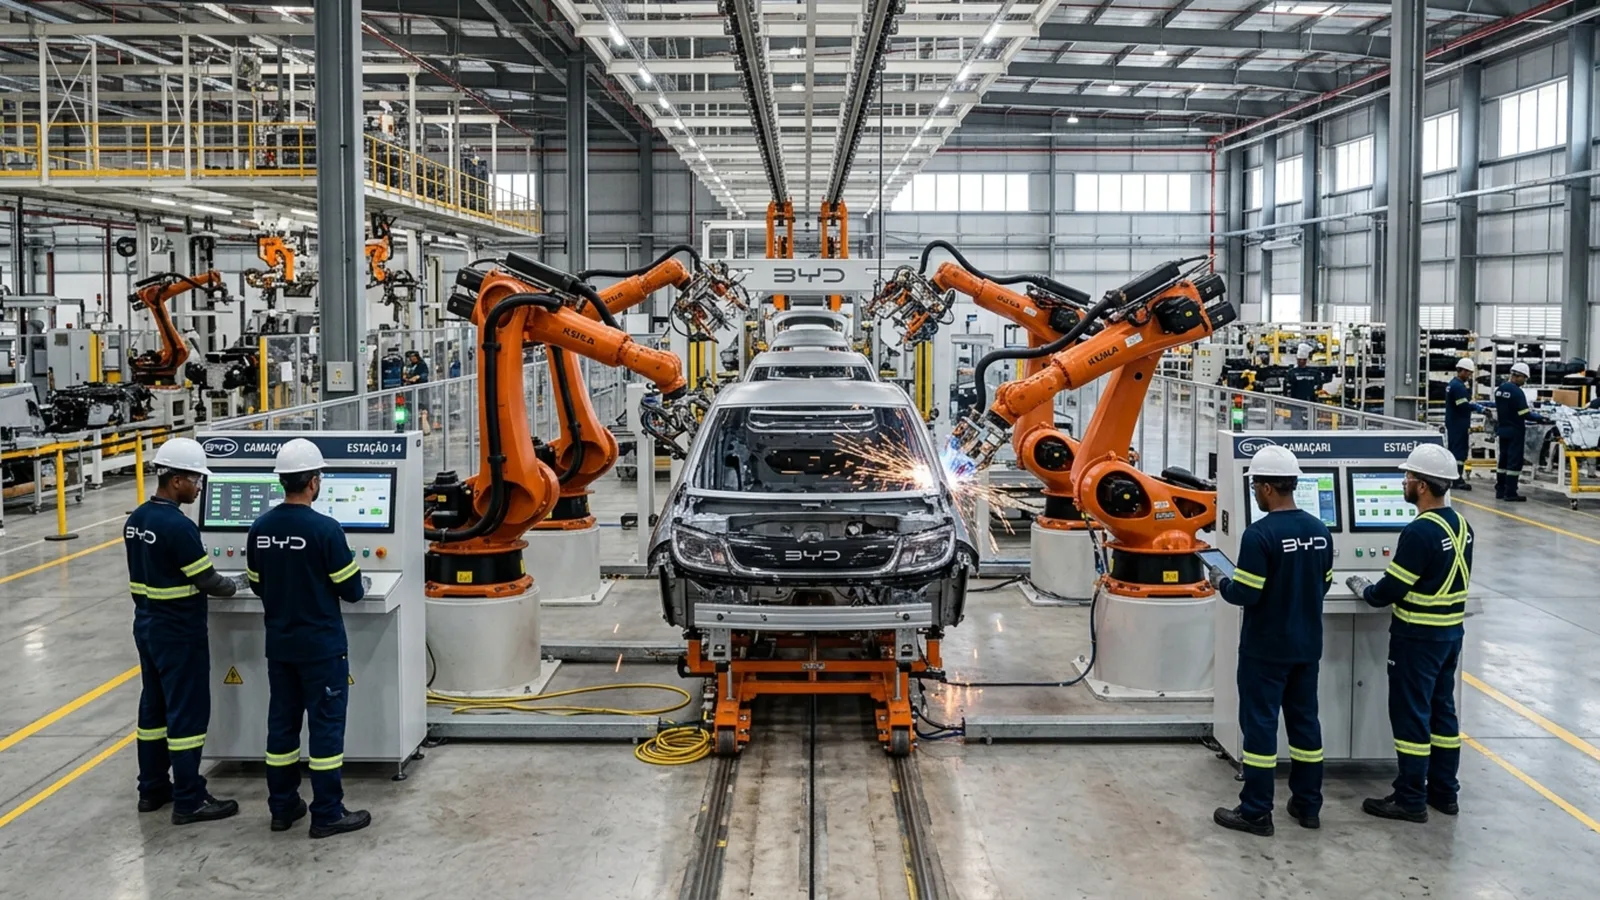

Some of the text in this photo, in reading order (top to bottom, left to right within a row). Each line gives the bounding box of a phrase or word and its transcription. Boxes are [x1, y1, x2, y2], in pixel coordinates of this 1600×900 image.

[774, 268, 845, 283] BYD
[205, 441, 402, 455] BYD CAMAÇ ESTAÇÃO 14
[126, 526, 157, 545] BYD
[257, 536, 307, 550] BYD
[1281, 536, 1328, 552] BYD
[785, 550, 841, 561] BYD
